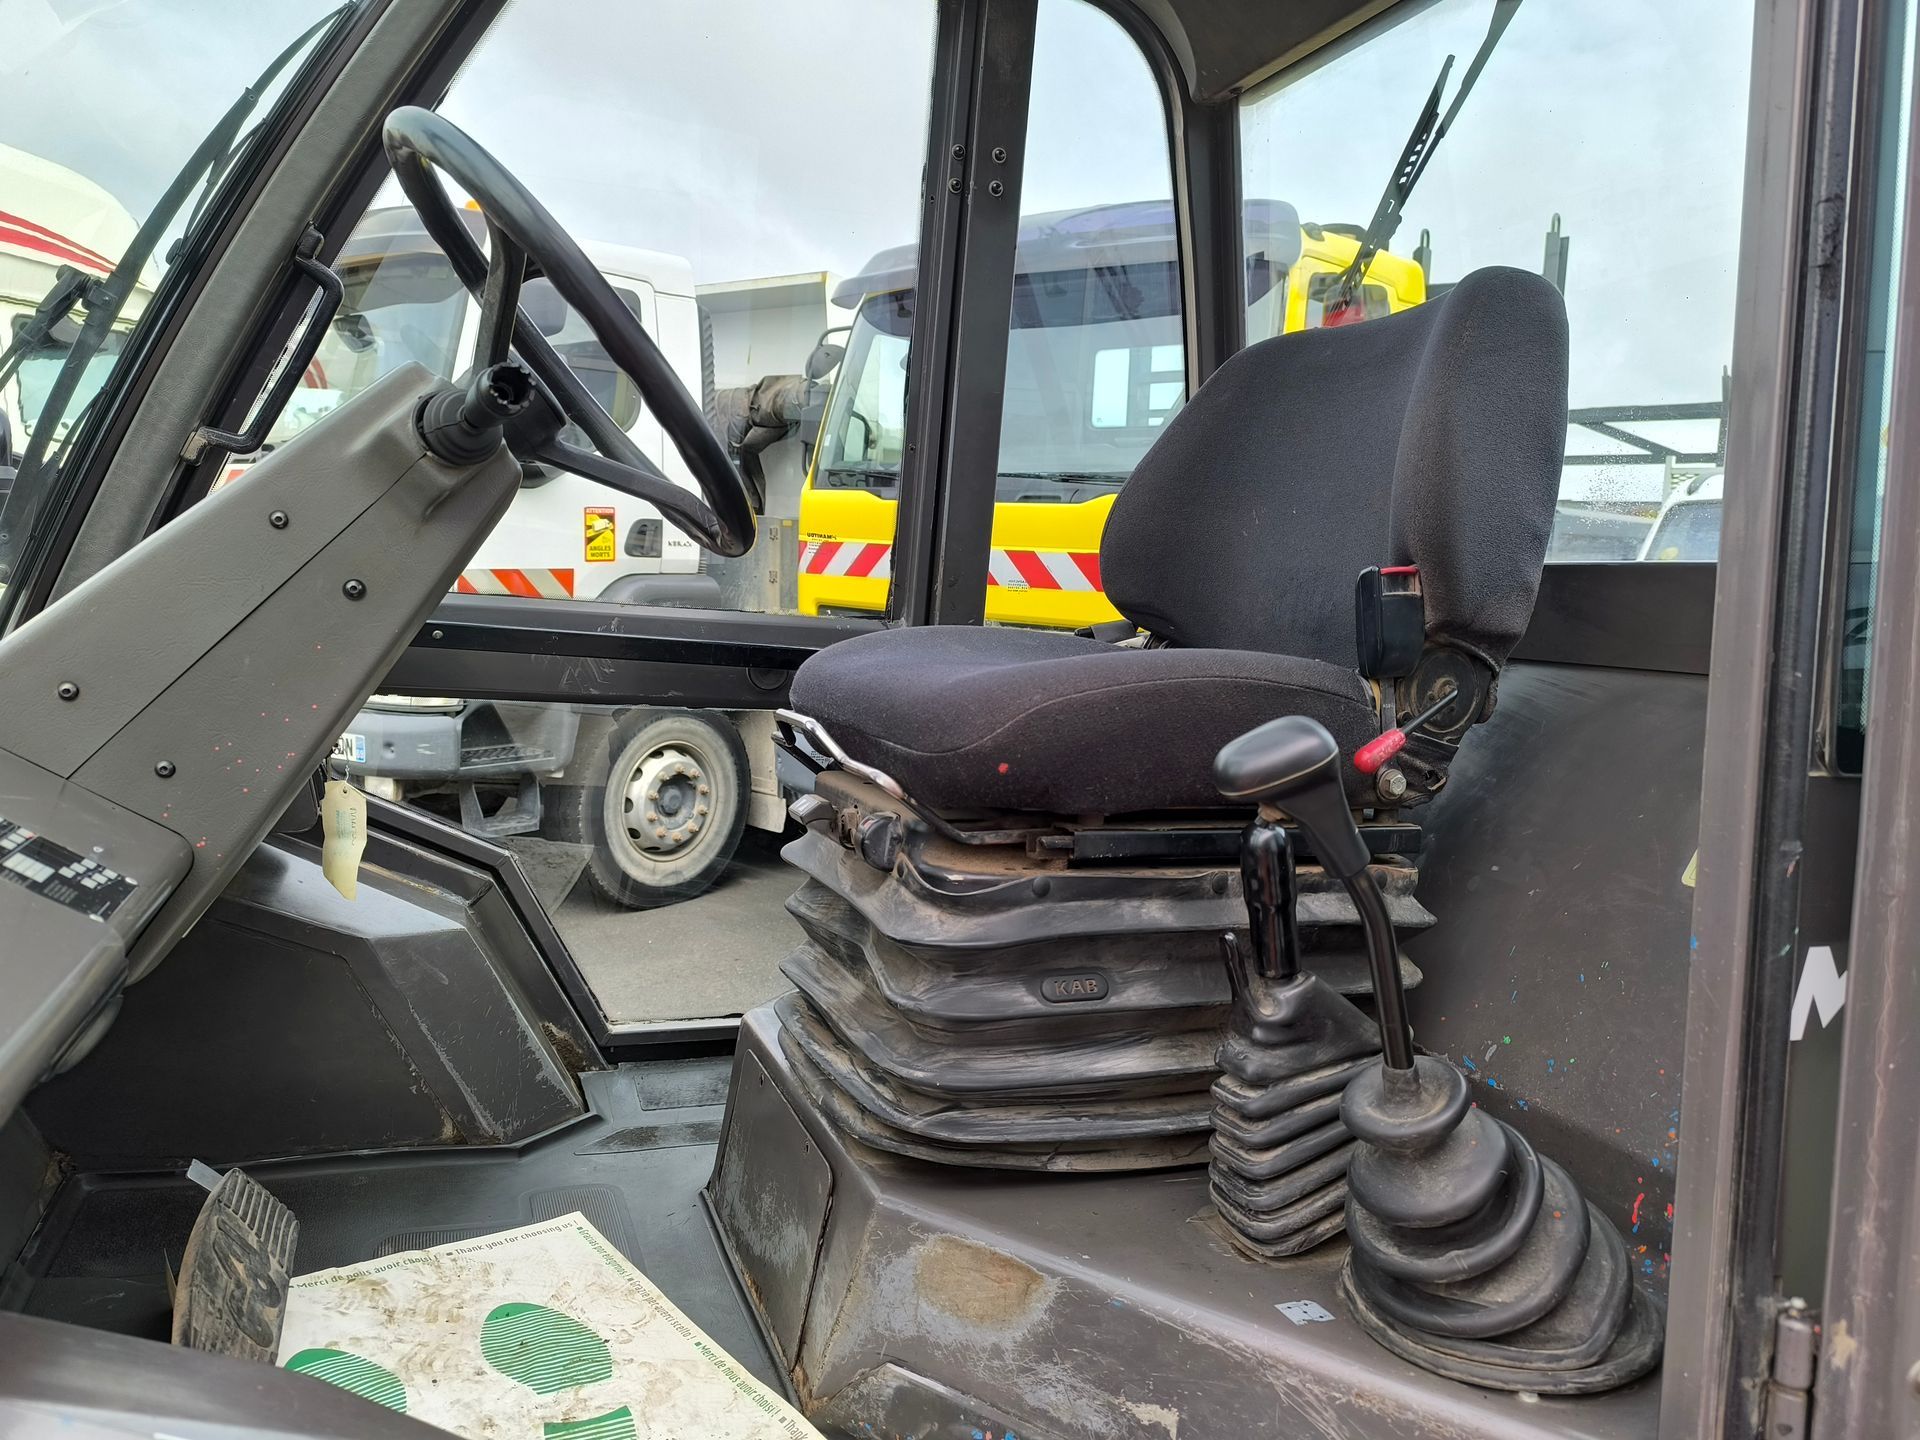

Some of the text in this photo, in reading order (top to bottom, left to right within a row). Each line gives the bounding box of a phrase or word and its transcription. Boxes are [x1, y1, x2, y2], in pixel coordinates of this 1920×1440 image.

[1054, 979, 1098, 996] KAB
[455, 1244, 485, 1256] Thank
[485, 1240, 504, 1251] you
[505, 1235, 519, 1245] for
[520, 1224, 562, 1240] choosing
[563, 1222, 574, 1230] us
[296, 1278, 329, 1289] Merci
[331, 1273, 344, 1283] de
[346, 1268, 372, 1280] nous
[630, 1280, 651, 1298] Grazie
[699, 1344, 719, 1363] Merci
[714, 1356, 727, 1370] de
[721, 1365, 741, 1383] nous
[752, 1392, 778, 1415] choisi
[784, 1419, 809, 1440] Thank
